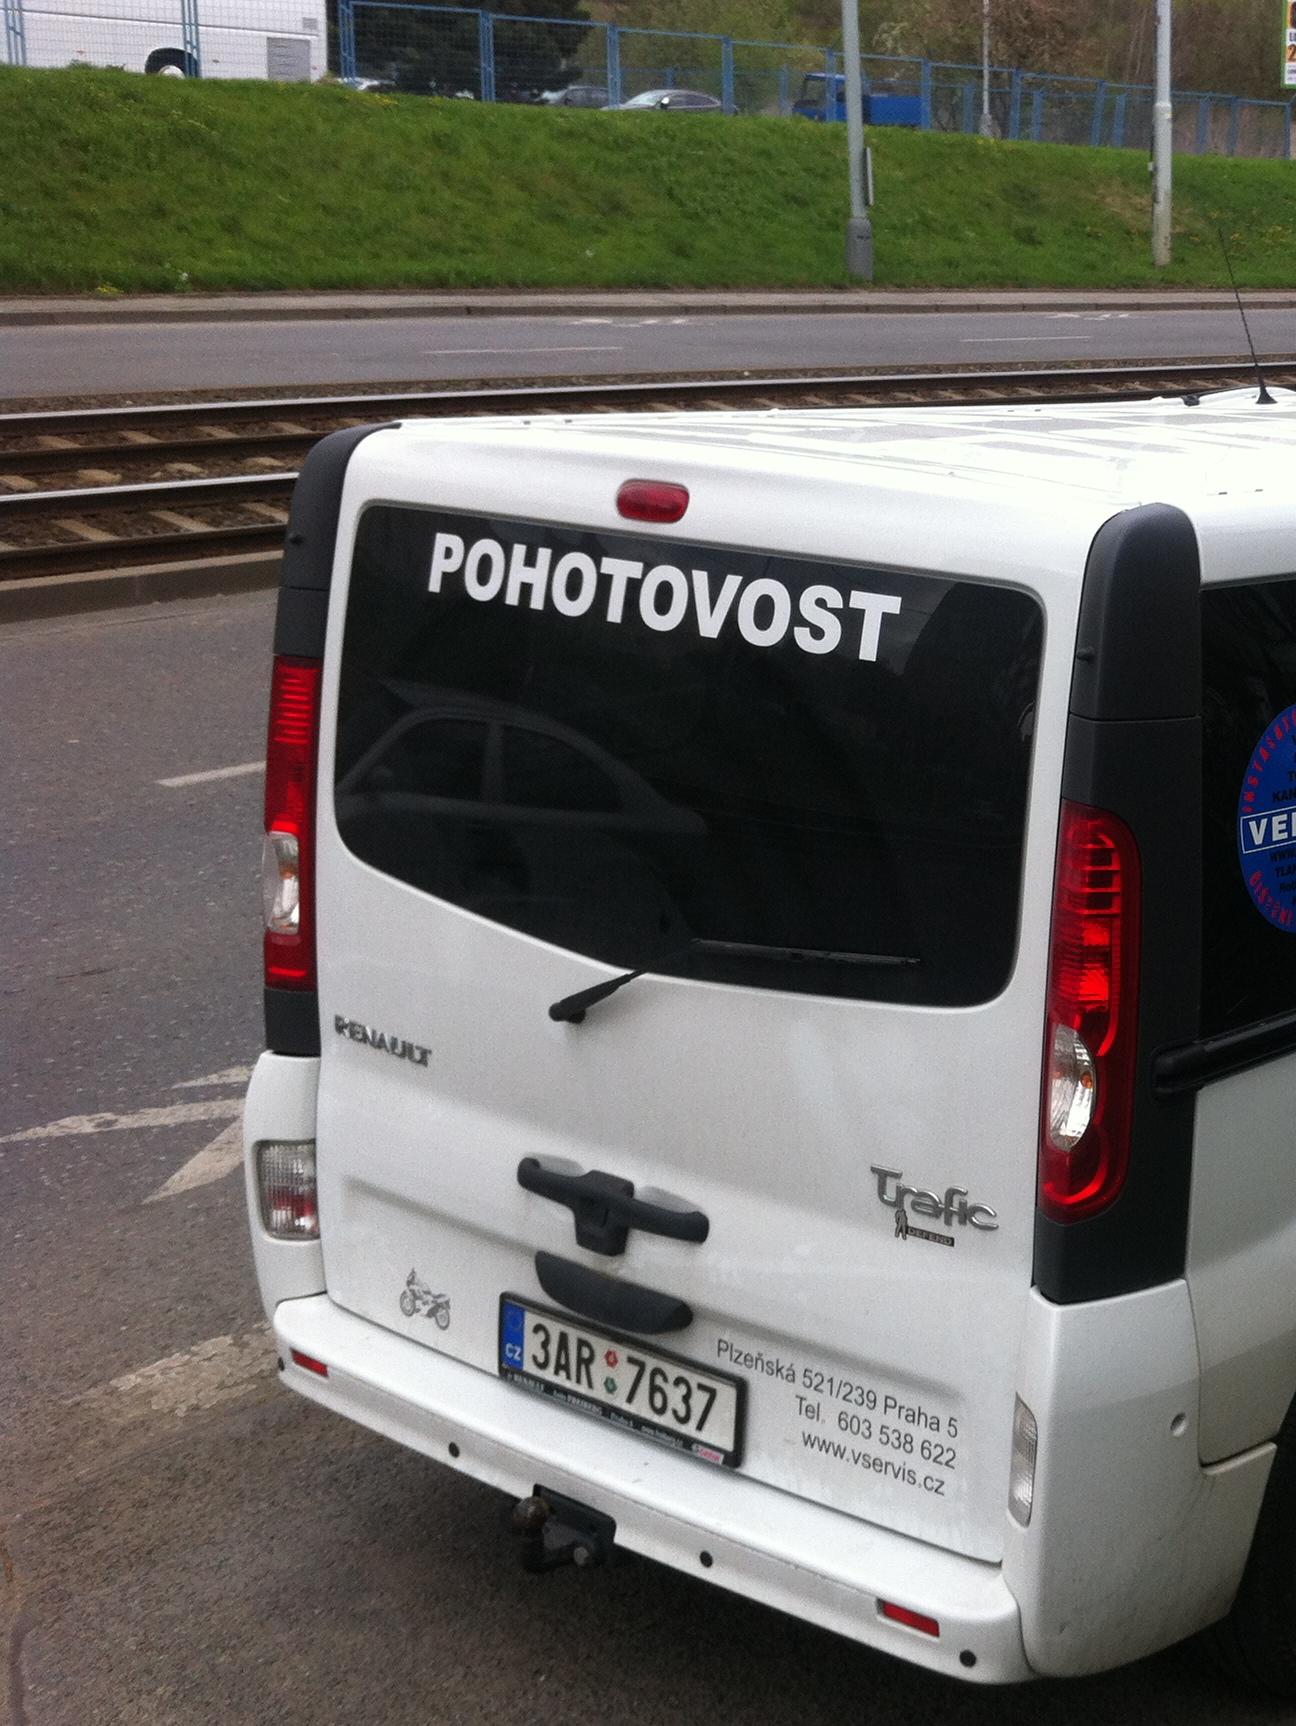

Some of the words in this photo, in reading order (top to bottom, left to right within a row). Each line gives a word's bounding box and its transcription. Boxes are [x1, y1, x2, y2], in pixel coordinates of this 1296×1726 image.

[428, 533, 902, 662] POHOTOVOST
[334, 1014, 432, 1067] RENAULT
[870, 1164, 999, 1231] Trafic
[504, 1343, 521, 1362] CZ
[531, 1323, 595, 1390] 3AR
[624, 1356, 717, 1433] 7637
[717, 1338, 796, 1384] Plzeňská
[801, 1369, 878, 1411] 521/239
[883, 1394, 941, 1434] Praha
[947, 1416, 959, 1439] 5
[795, 1394, 827, 1424] Tel.
[837, 1411, 873, 1439] 603
[878, 1424, 914, 1455] 538
[919, 1440, 957, 1470] 622
[801, 1432, 945, 1496] www.vservis.cz
